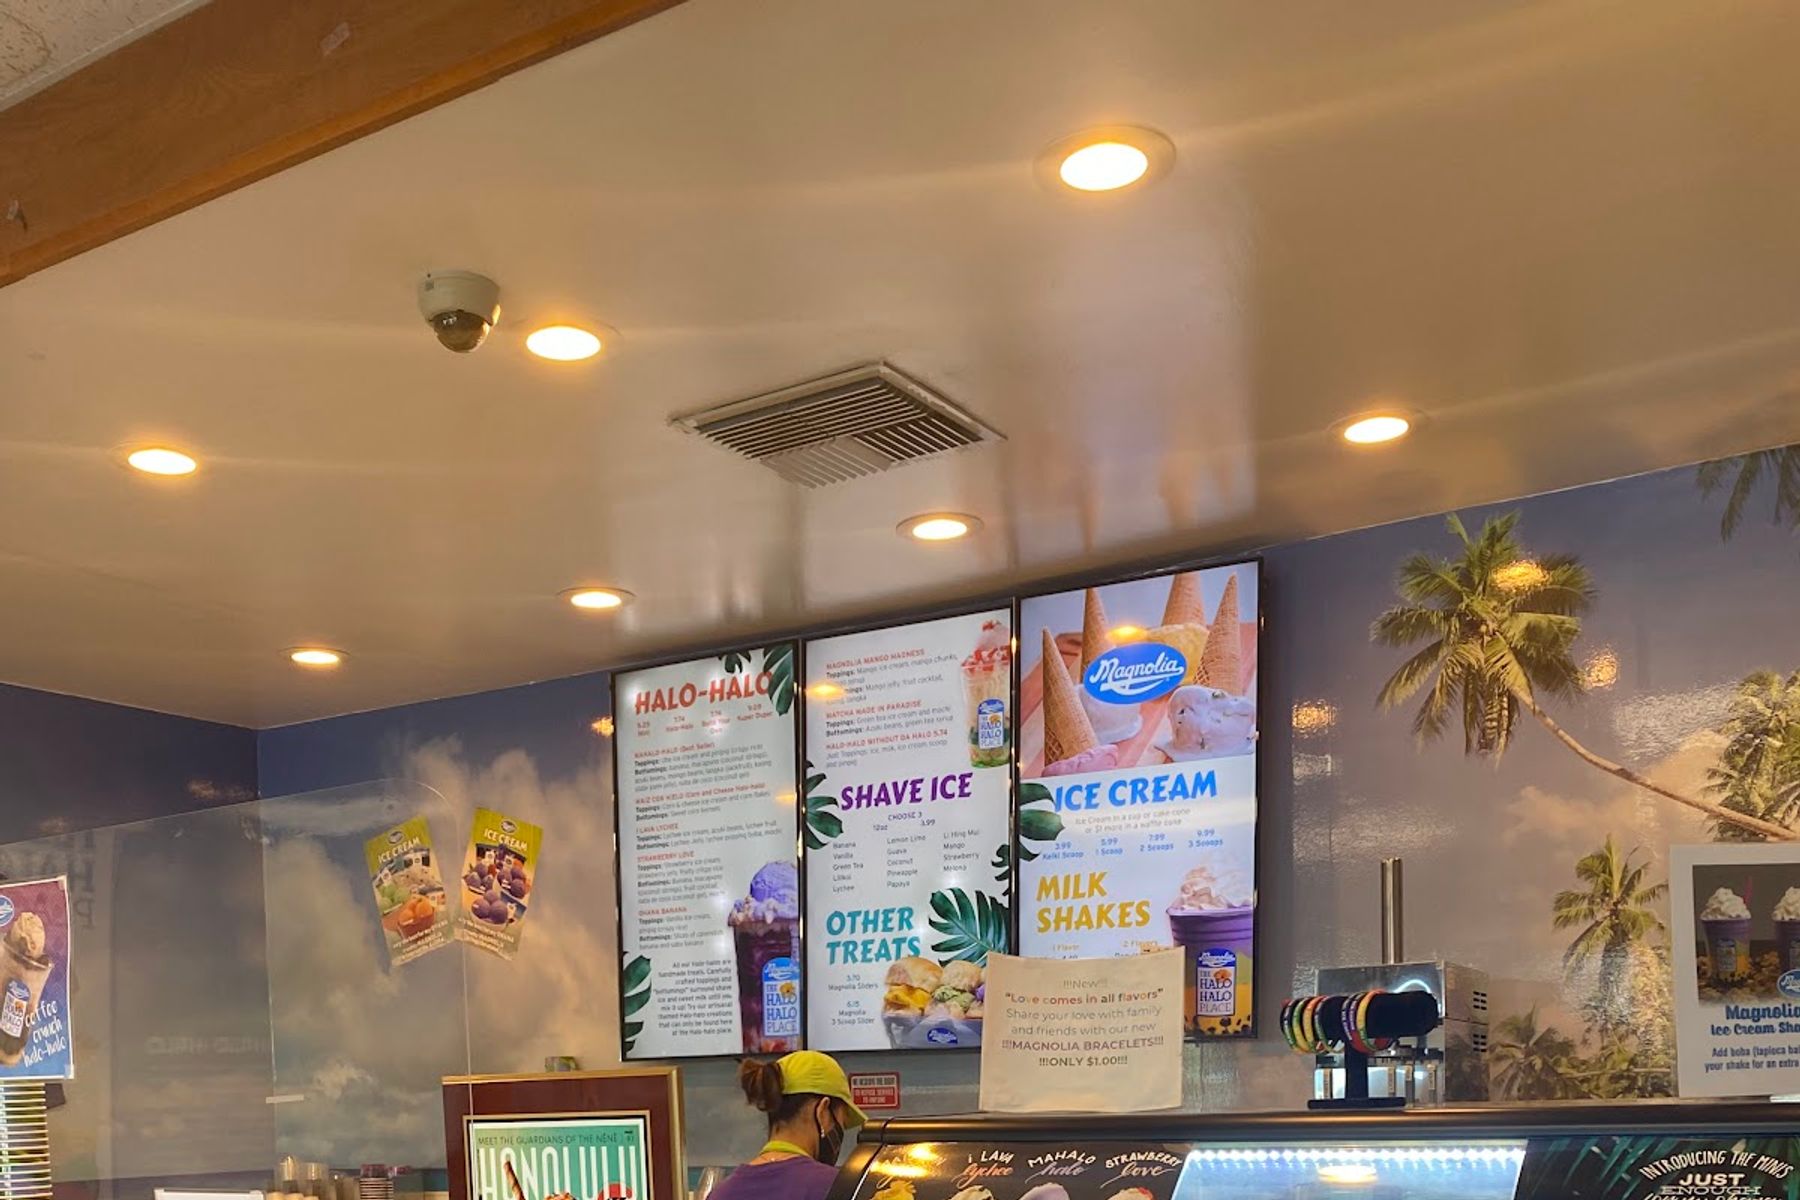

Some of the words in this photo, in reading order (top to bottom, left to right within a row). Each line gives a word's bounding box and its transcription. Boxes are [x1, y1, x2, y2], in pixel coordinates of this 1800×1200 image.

[1089, 652, 1185, 694] Magnolia
[635, 671, 772, 715] HALO-HALO
[841, 777, 923, 810] SHAVE
[931, 772, 972, 801] ICE
[1055, 783, 1100, 812] ICE
[1108, 770, 1217, 806] CREAM
[888, 812, 915, 821] CHOOSE
[484, 829, 497, 840] ICE
[499, 833, 527, 851] CREAM
[943, 842, 965, 850] Mango
[377, 851, 391, 864] ICE
[392, 837, 421, 858] CREAM
[943, 852, 978, 862] Strawberry
[887, 858, 912, 866] Coconut
[887, 869, 917, 877] Pineapple
[1036, 872, 1107, 902] MILK
[826, 905, 913, 935] OTHER
[1037, 900, 1151, 934] SHAKES
[826, 936, 920, 965] TREATS
[1200, 979, 1232, 989] HALO
[1043, 997, 1082, 1005] comes
[1086, 994, 1097, 1004] in
[1101, 993, 1114, 1003] all
[1200, 991, 1231, 1001] HALO
[767, 1007, 796, 1020] HALO
[1006, 1008, 1040, 1020] Share
[1042, 1012, 1068, 1022] your
[1072, 1010, 1095, 1020] love
[1098, 1009, 1124, 1019] with
[1126, 1006, 1162, 1018] family
[1200, 1003, 1231, 1013] PLACE
[1726, 1003, 1800, 1022] Magnolia
[1011, 1025, 1033, 1035] and
[1036, 1025, 1077, 1036] friends
[1080, 1026, 1106, 1036] with
[1109, 1025, 1128, 1034] our
[1131, 1023, 1156, 1032] new
[1711, 1024, 1731, 1036] Ice
[1734, 1023, 1775, 1035] Cream
[1712, 1047, 1728, 1057] Add
[1730, 1046, 1750, 1056] boba
[1704, 1062, 1723, 1073] your
[1726, 1061, 1750, 1069] shake
[1752, 1060, 1764, 1069] for
[1766, 1060, 1776, 1068] an
[1779, 1059, 1799, 1068] extra
[478, 1136, 498, 1146] MEET
[500, 1135, 513, 1145] THE
[516, 1134, 563, 1145] GUARDIANS
[566, 1134, 576, 1144] OF
[579, 1134, 594, 1143] THE
[1028, 1150, 1097, 1168] MAHALO
[1105, 1151, 1183, 1169] STRAWBERRY
[1639, 1150, 1727, 1181] INTRODUCING
[1731, 1150, 1757, 1167] THE
[1754, 1155, 1794, 1179] MINIS
[953, 1165, 1014, 1188] lychee
[1033, 1162, 1089, 1180] halo
[1679, 1173, 1746, 1186] JUST
[1660, 1186, 1762, 1196] ENOUGH
